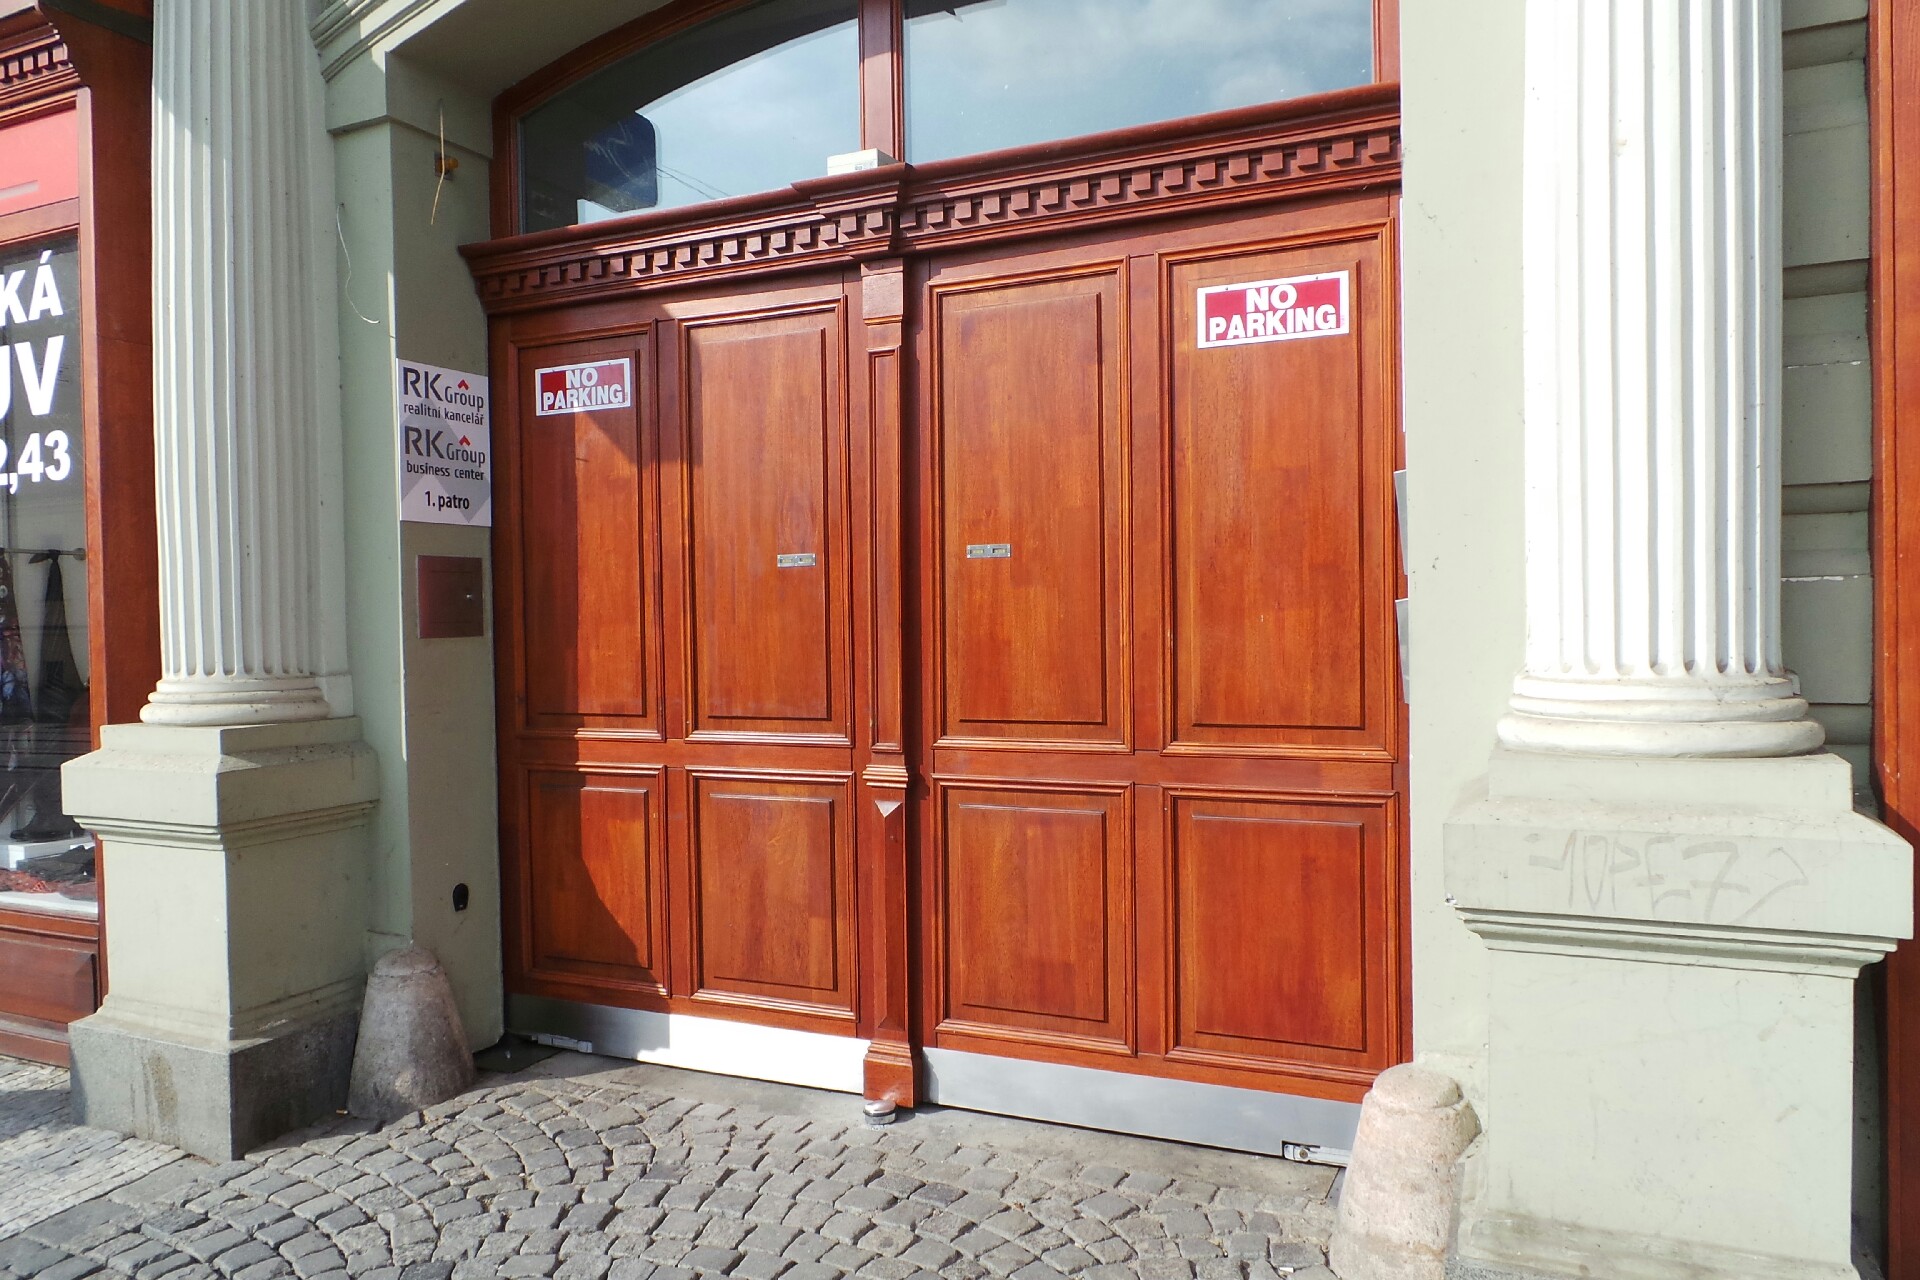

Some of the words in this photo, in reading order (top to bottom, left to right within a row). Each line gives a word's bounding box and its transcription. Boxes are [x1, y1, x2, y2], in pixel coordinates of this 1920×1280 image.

[1246, 284, 1298, 313] NO
[1209, 304, 1337, 342] PARKING
[403, 367, 443, 401] RK
[445, 386, 484, 410] Group
[565, 369, 598, 390] NO
[543, 384, 623, 411] PARKING
[403, 403, 441, 419] realitní
[444, 408, 484, 426] kancelář
[404, 425, 445, 459] RK
[446, 443, 486, 468] Group
[406, 460, 450, 477] business
[454, 467, 485, 481] center
